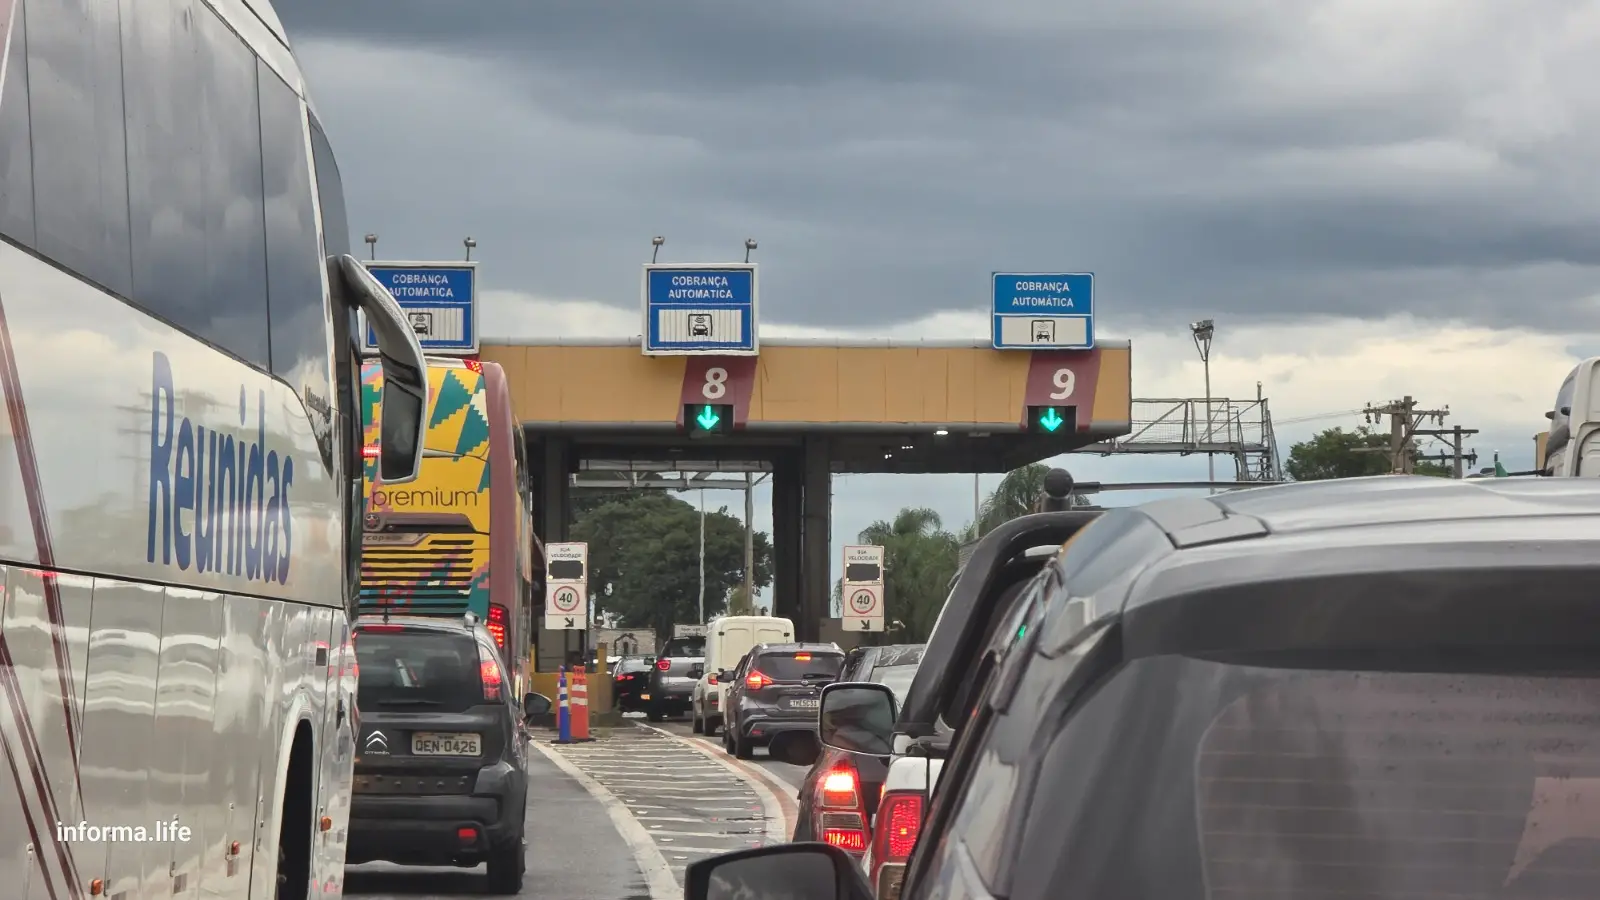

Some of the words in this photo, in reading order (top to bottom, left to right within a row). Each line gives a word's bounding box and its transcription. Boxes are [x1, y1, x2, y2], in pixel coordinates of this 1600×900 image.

[392, 274, 449, 286] COBRANÇA
[671, 276, 729, 288] COBRANÇA
[389, 287, 454, 298] AUTOMATICA
[1015, 281, 1070, 293] COBRANÇA
[668, 289, 733, 299] AUTOMATICA
[1012, 295, 1074, 307] AUTOMÁTICA
[702, 367, 728, 399] 8
[1050, 368, 1075, 400] 9
[147, 351, 294, 586] Reunidas
[372, 486, 478, 510] premium
[559, 593, 573, 603] 40
[856, 595, 870, 605] 40
